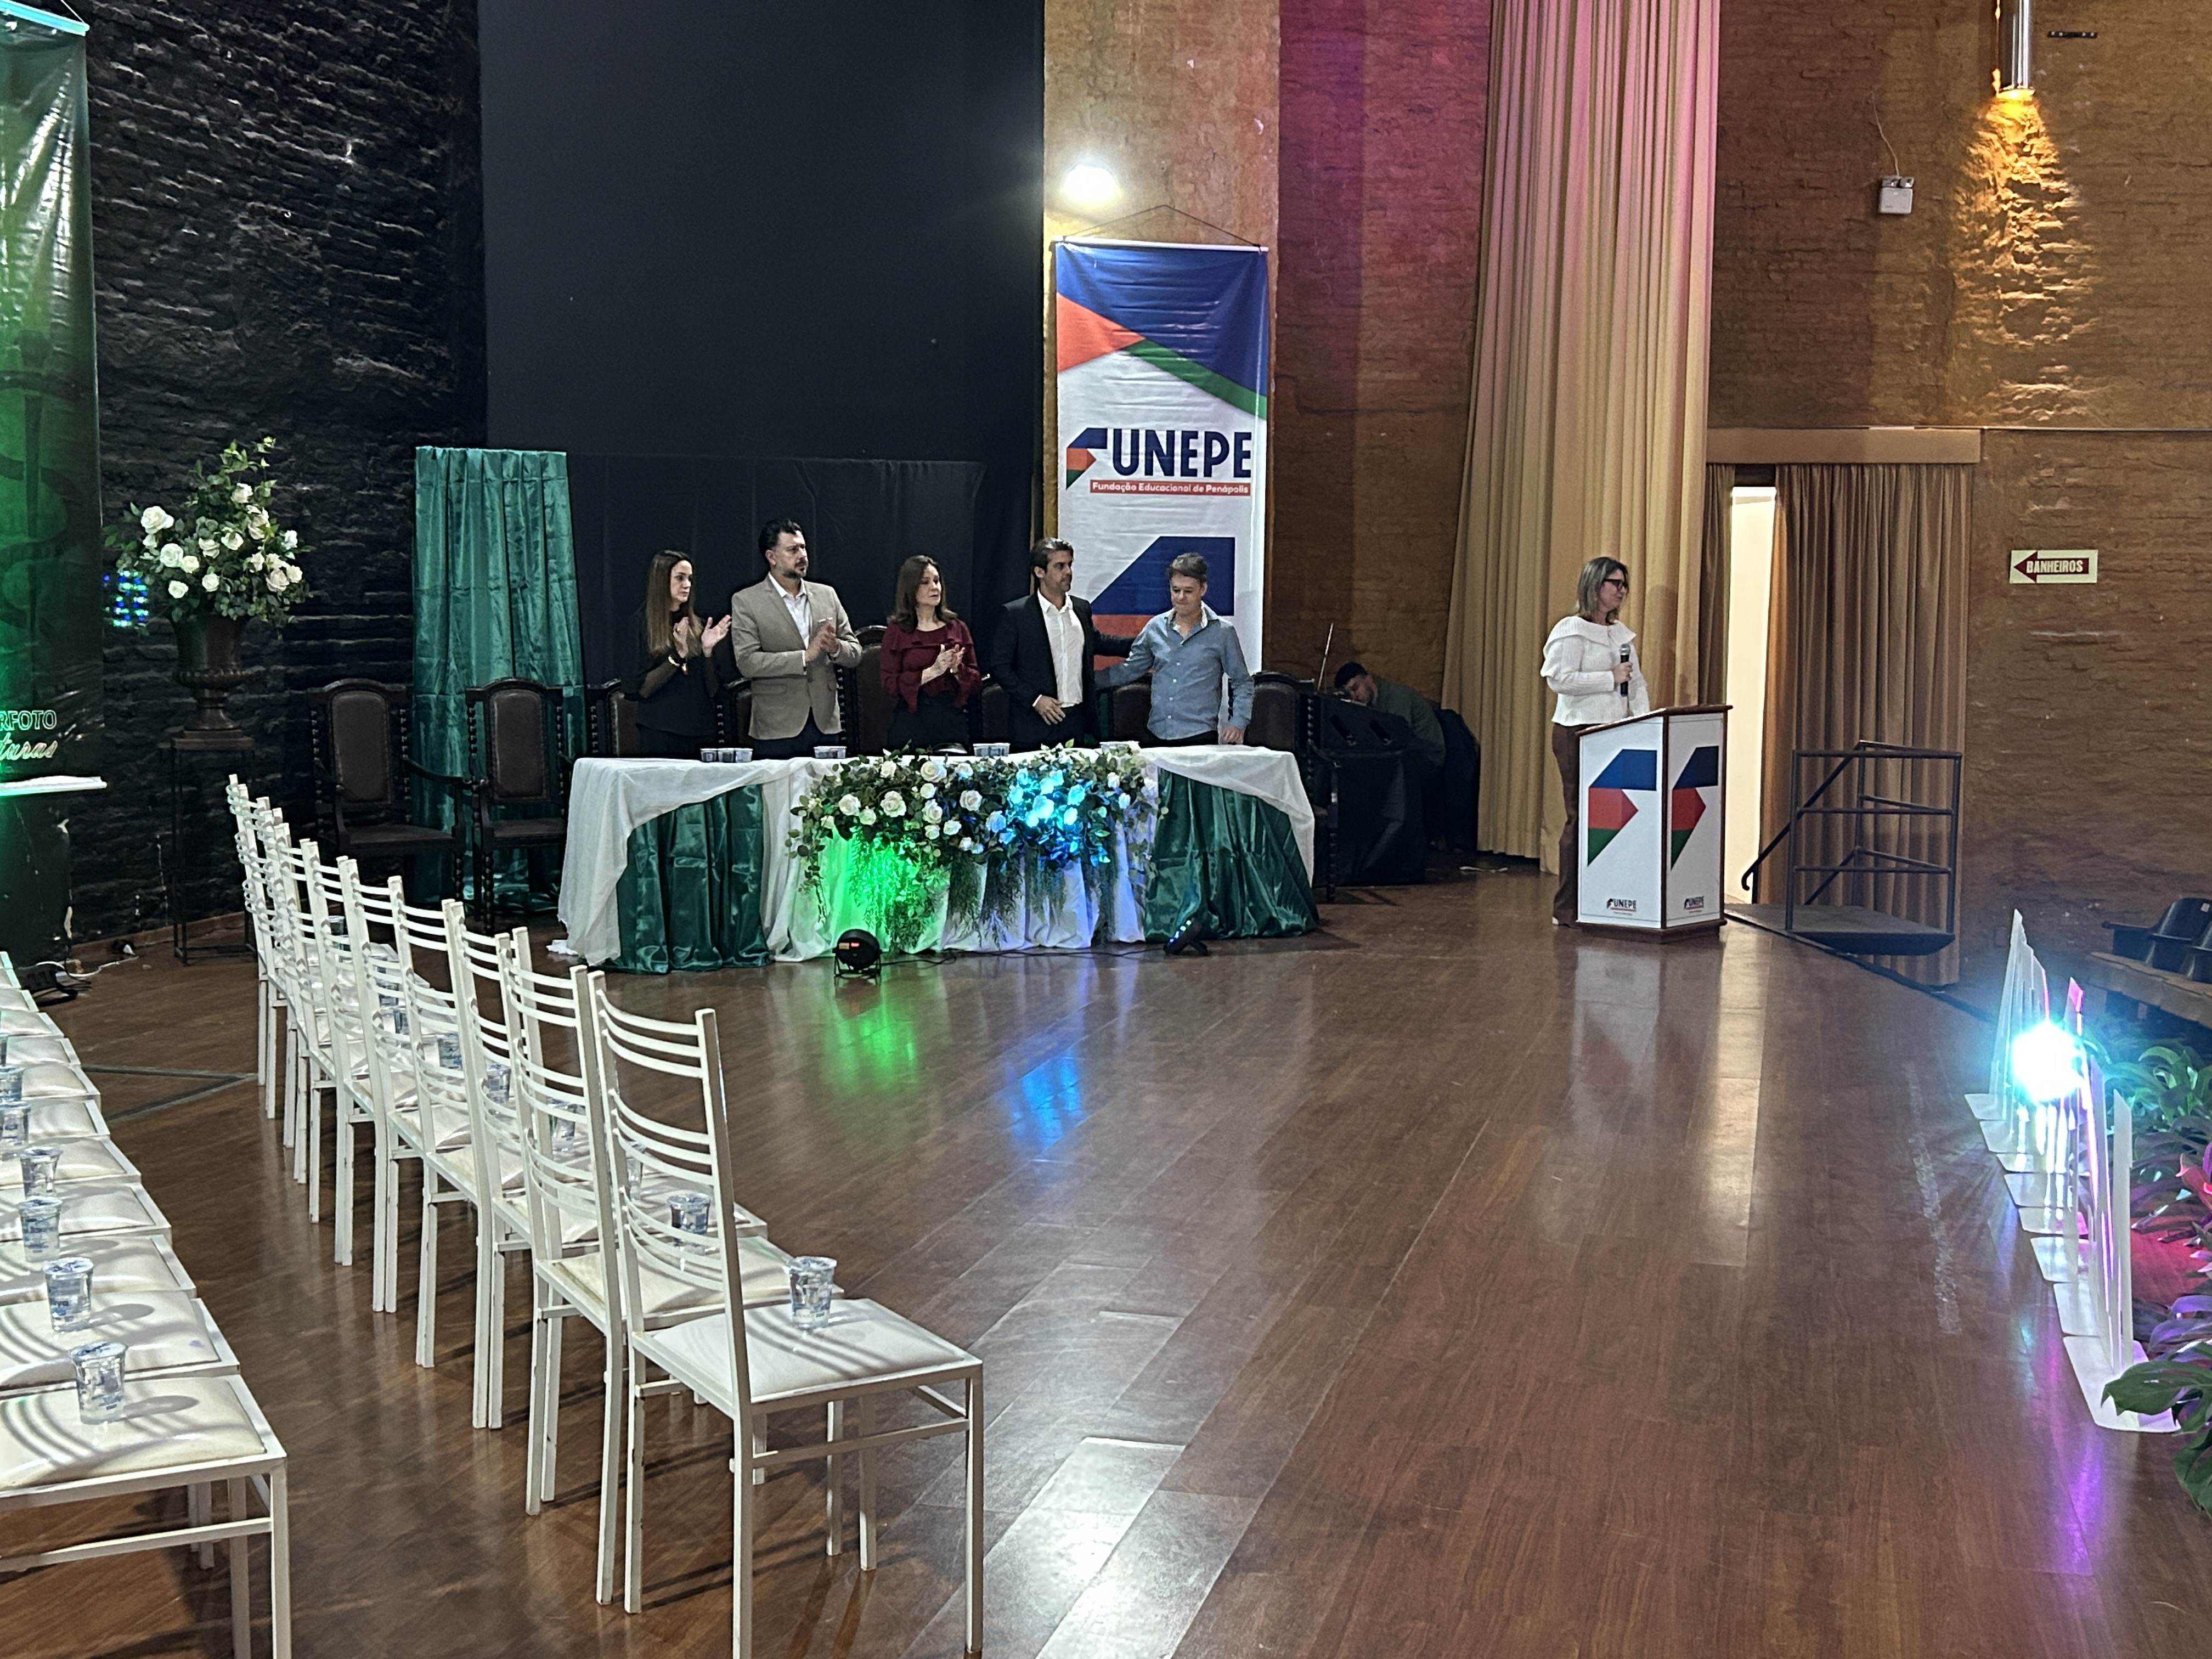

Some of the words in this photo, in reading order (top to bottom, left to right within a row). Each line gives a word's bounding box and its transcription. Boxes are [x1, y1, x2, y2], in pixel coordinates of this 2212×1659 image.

[1092, 482, 1137, 493] Fundação
[1138, 482, 1191, 492] Educacional
[1193, 484, 1204, 492] de
[1206, 484, 1249, 494] Penápolis
[2025, 560, 2084, 573] BANHEIROS
